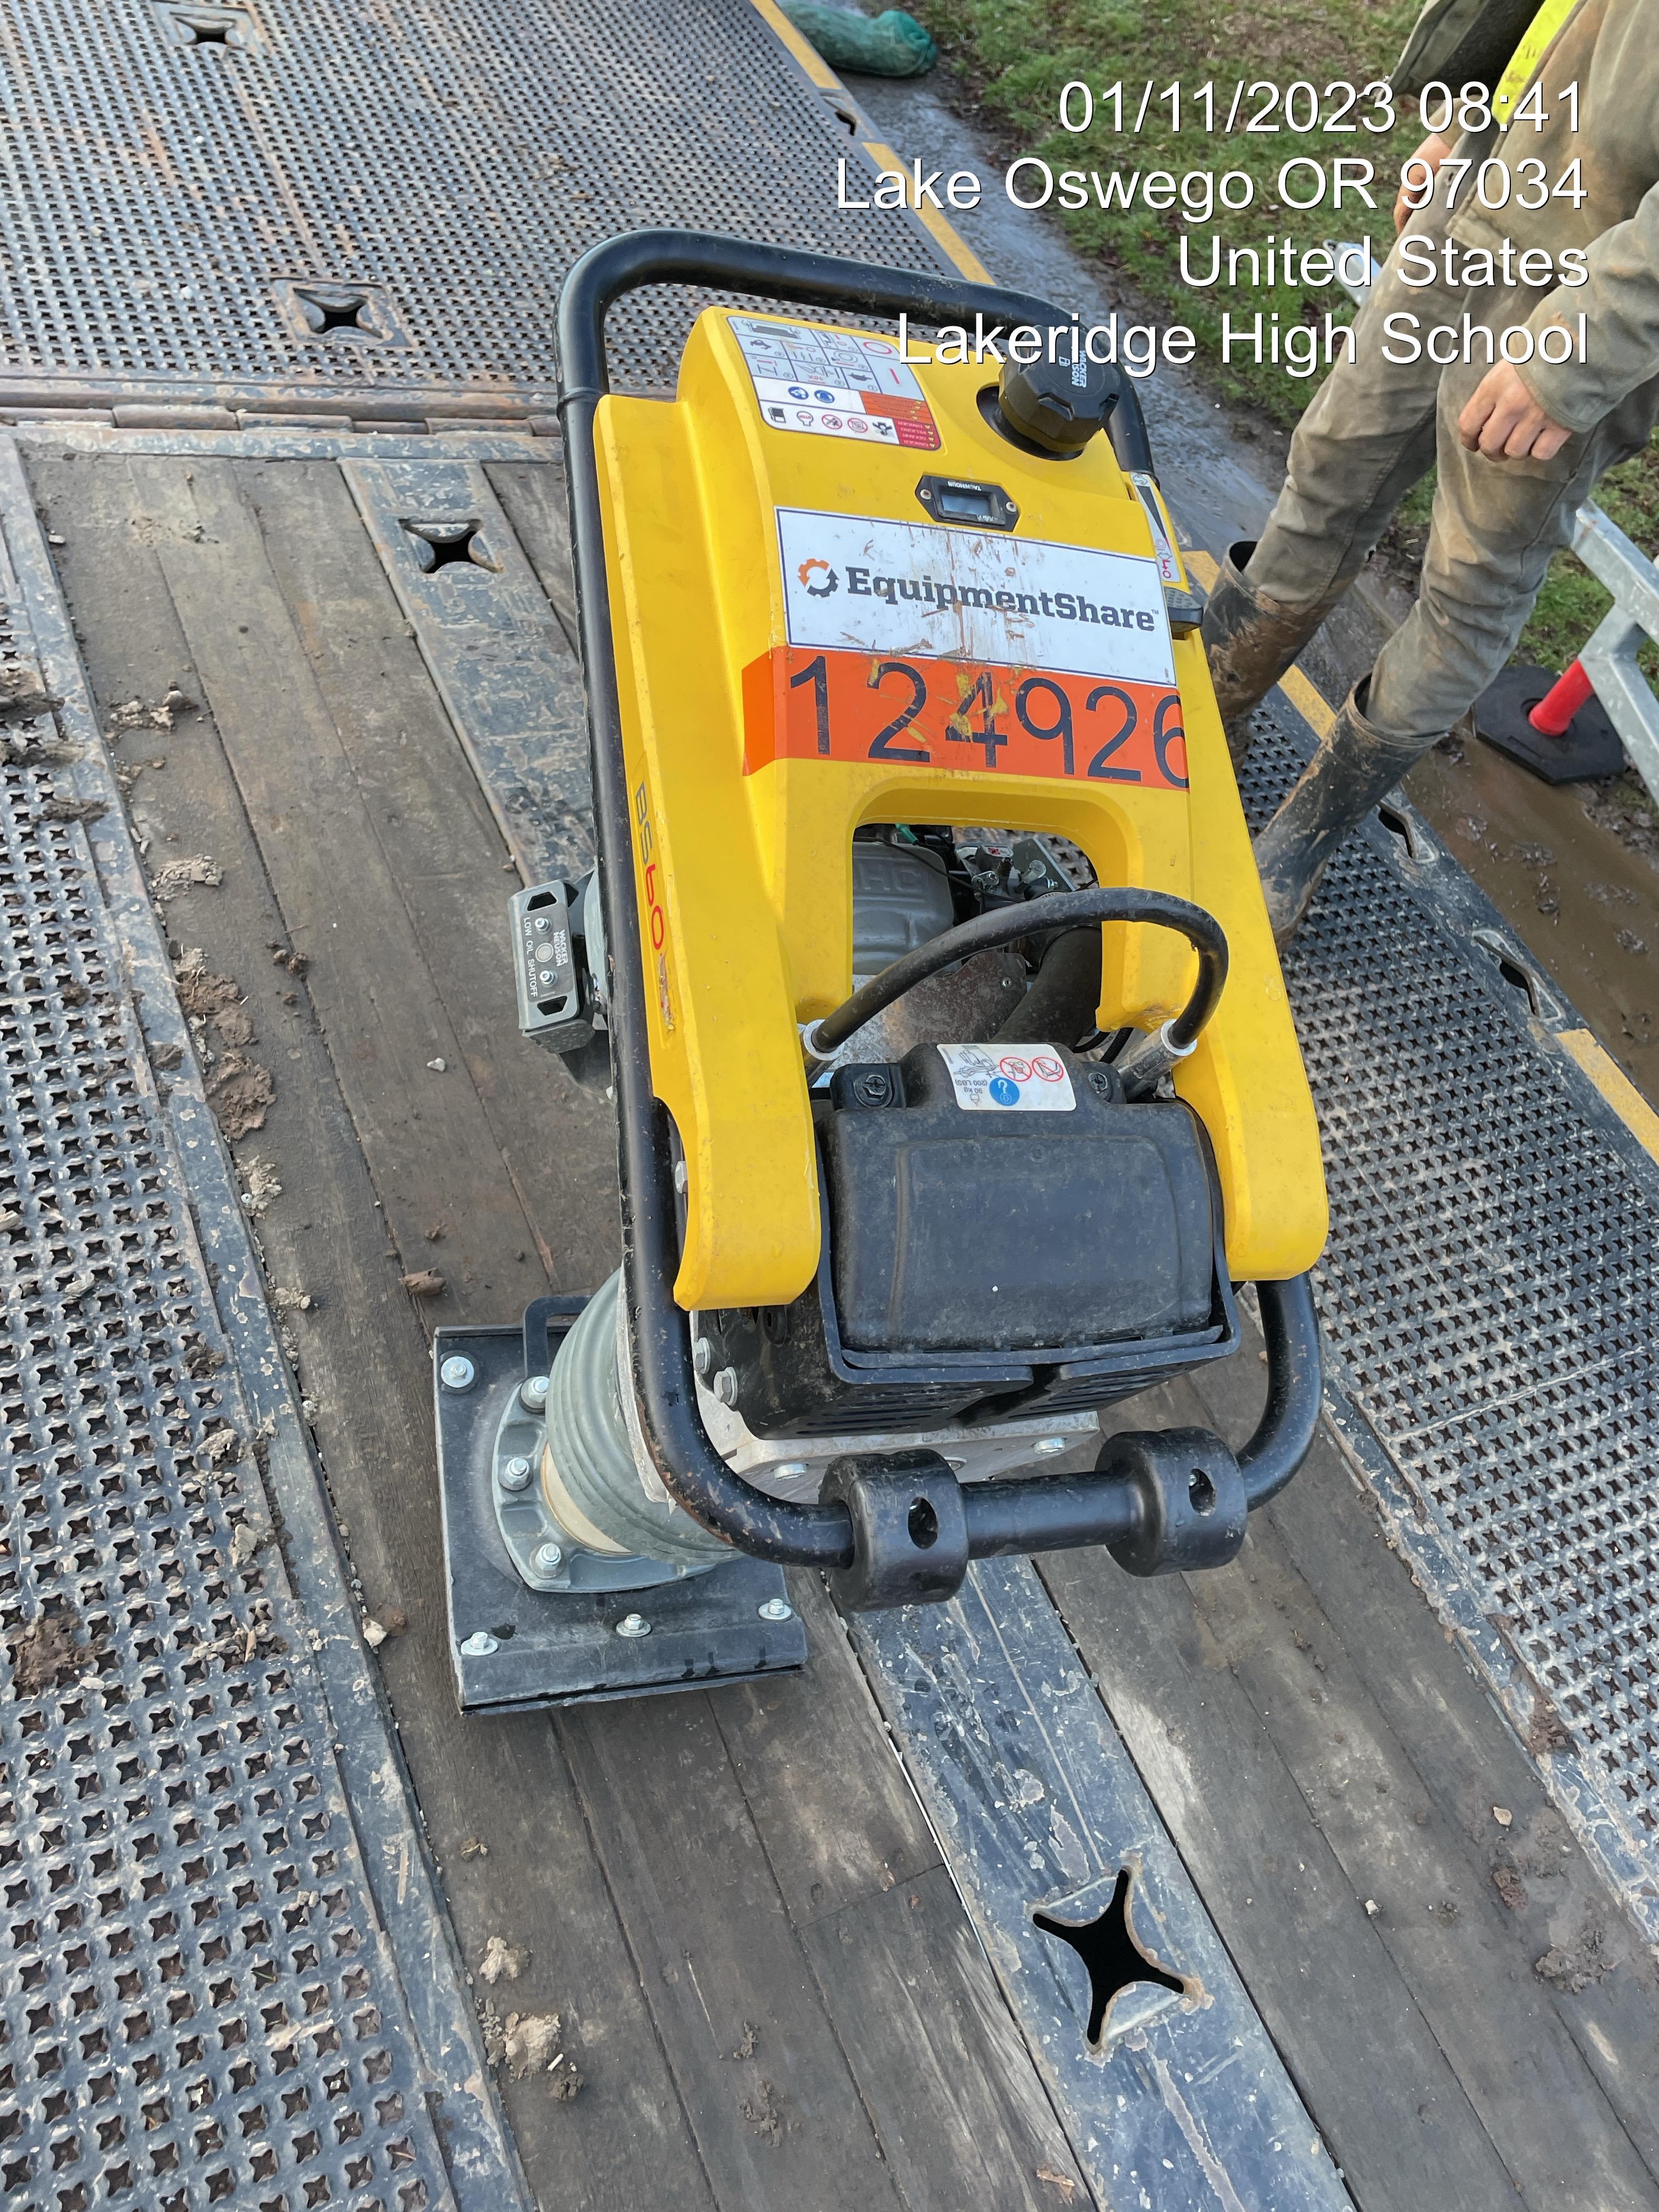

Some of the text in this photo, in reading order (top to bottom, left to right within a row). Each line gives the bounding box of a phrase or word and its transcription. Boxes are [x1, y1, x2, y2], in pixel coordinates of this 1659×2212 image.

[790, 655, 1189, 788] 124926
[523, 916, 538, 997] LOW OIL SHUTOFF
[553, 931, 563, 967] NEUSON
[558, 929, 568, 966] WACKER
